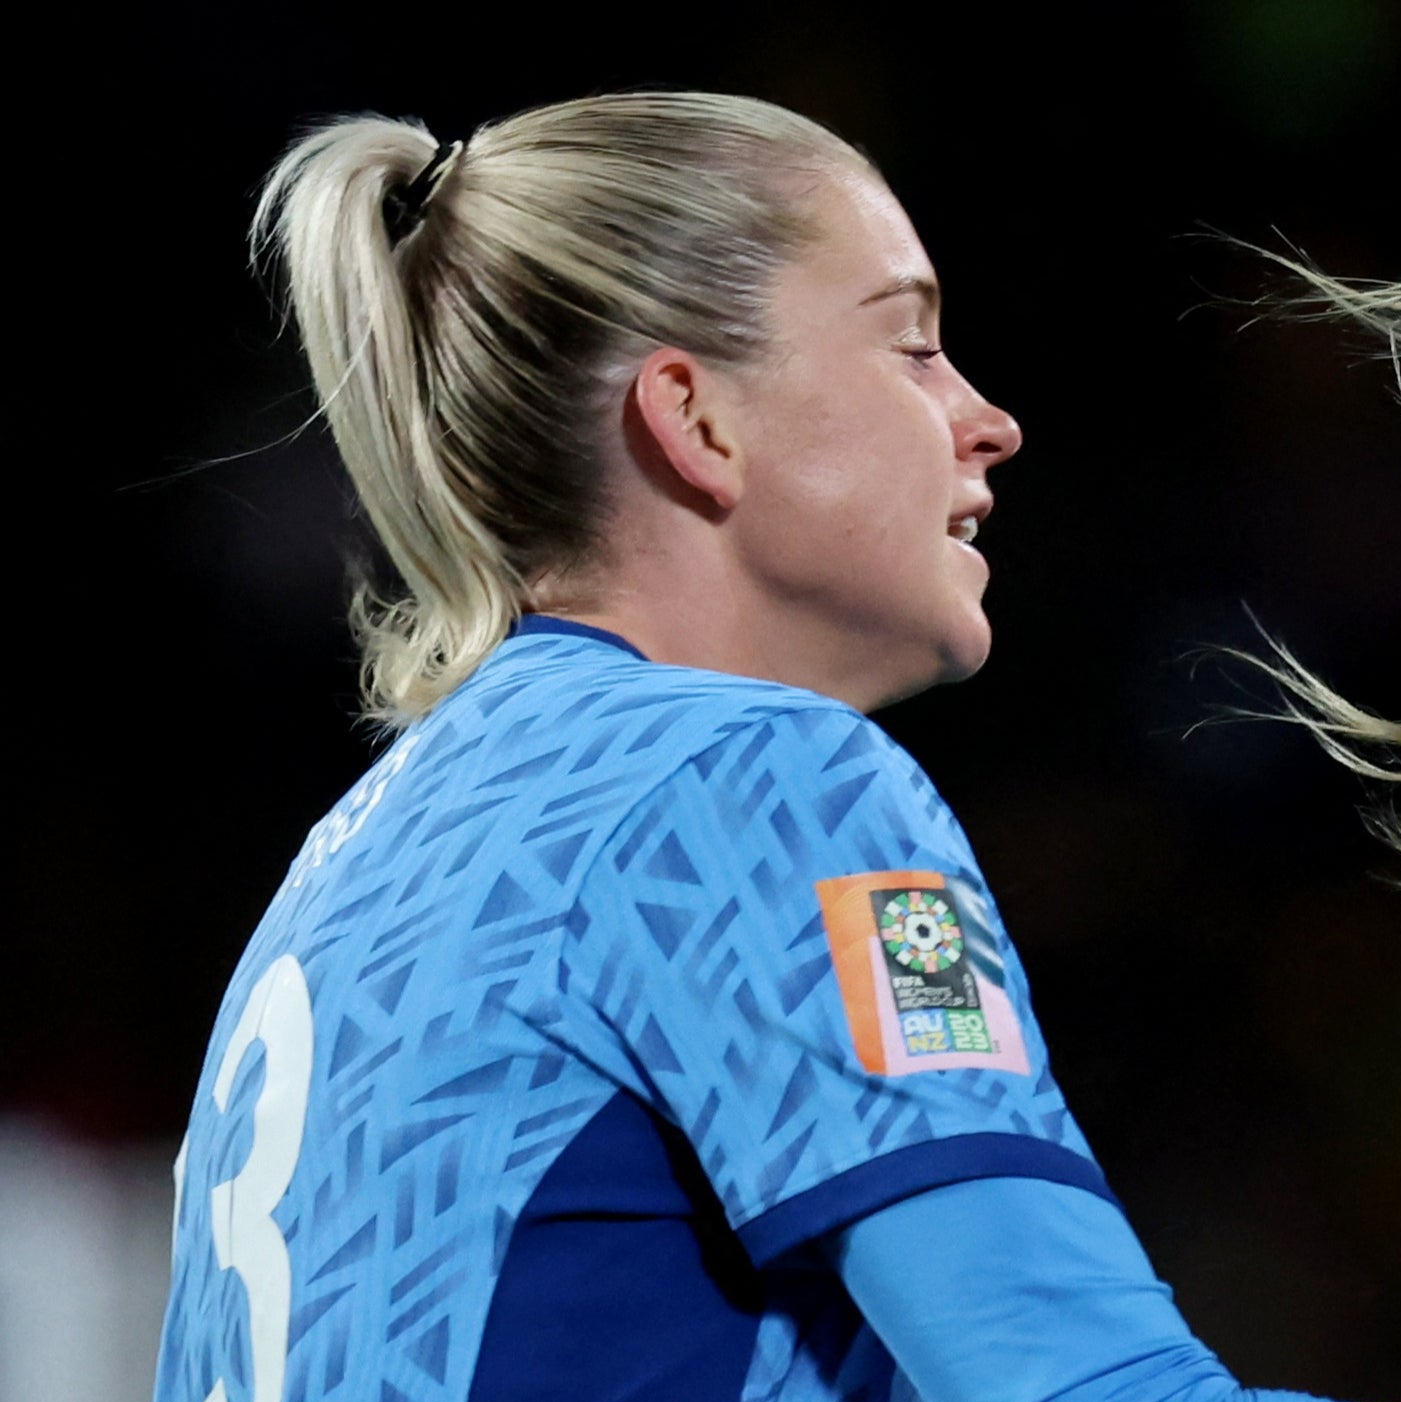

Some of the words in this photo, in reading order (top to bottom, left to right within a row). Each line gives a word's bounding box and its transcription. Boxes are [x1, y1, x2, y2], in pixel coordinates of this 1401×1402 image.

[904, 1013, 943, 1035] AU
[948, 1014, 984, 1032] 20
[908, 1032, 949, 1052] NZ
[953, 1031, 989, 1050] 23
